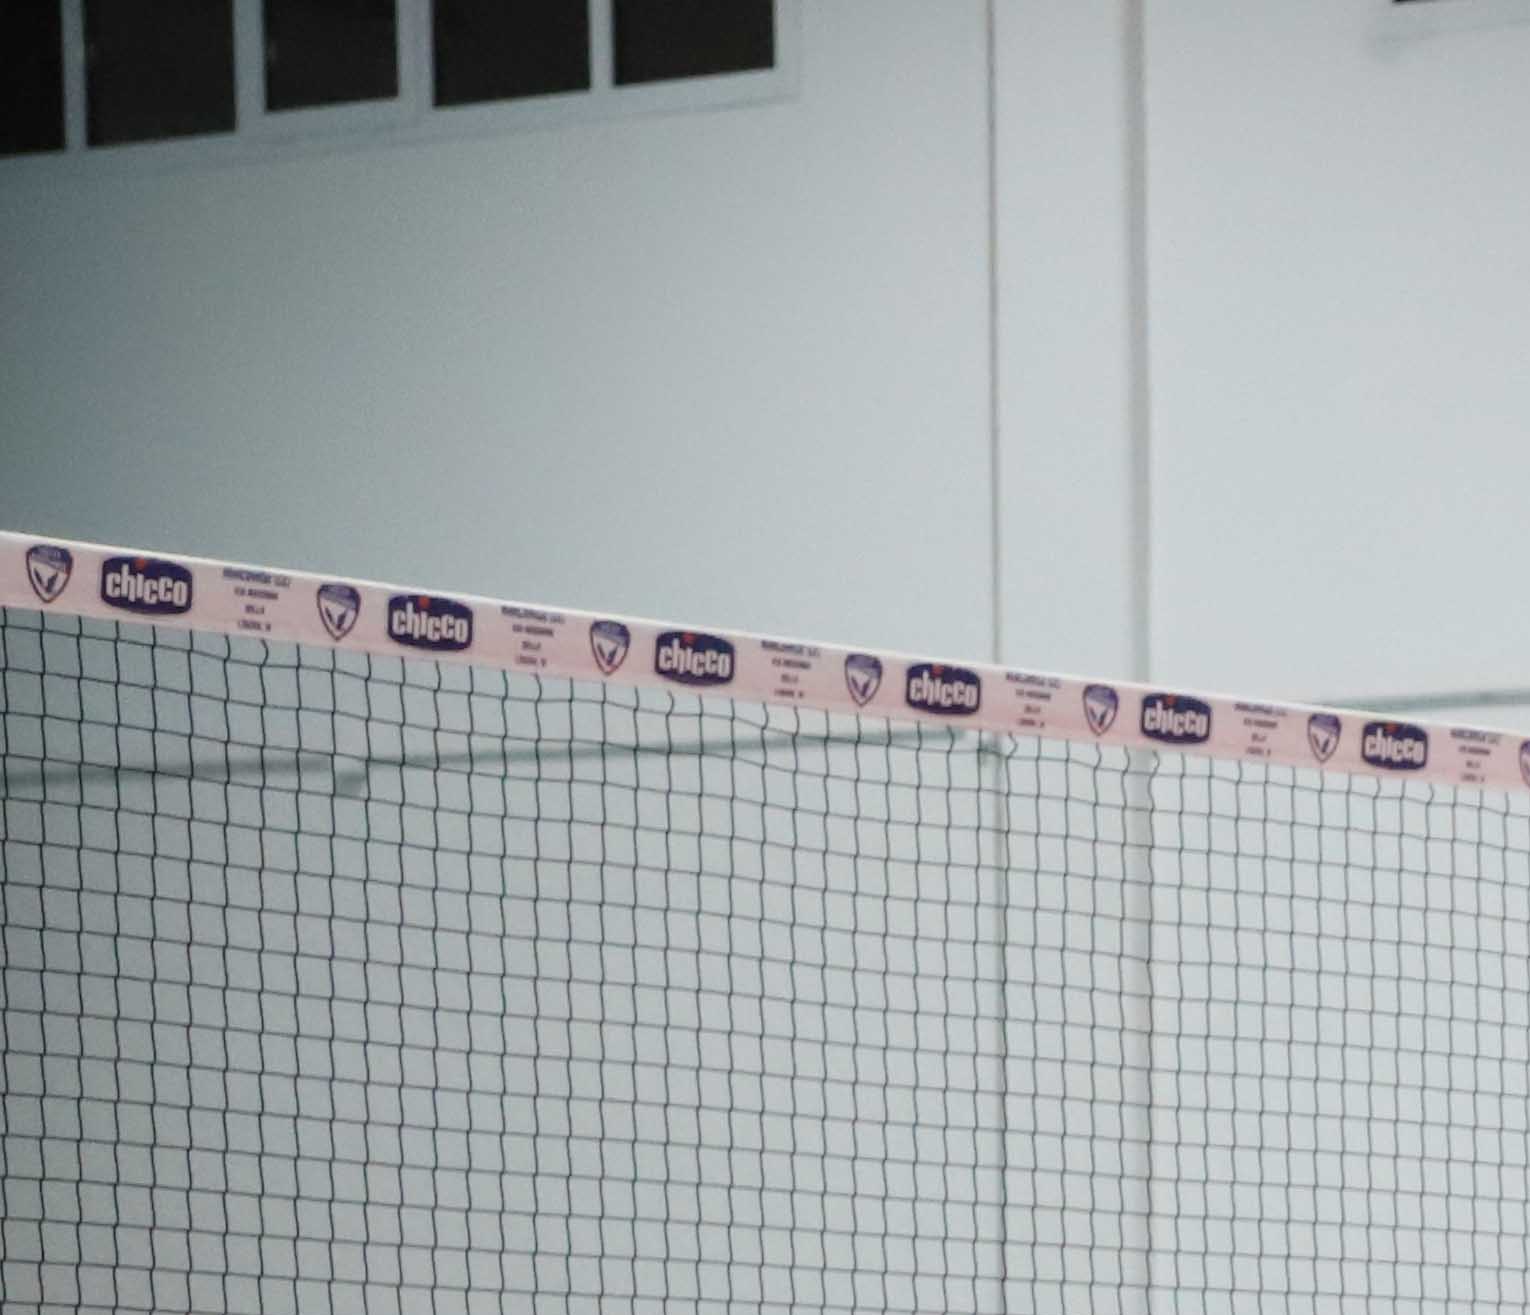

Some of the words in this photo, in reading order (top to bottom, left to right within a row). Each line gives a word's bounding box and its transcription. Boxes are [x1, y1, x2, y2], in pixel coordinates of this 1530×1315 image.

[106, 564, 188, 606] chicco
[391, 603, 469, 645] chicco
[658, 637, 732, 678] chicco
[909, 668, 979, 709] chicco
[1143, 697, 1210, 738] chicco
[1364, 727, 1426, 763] chicco
